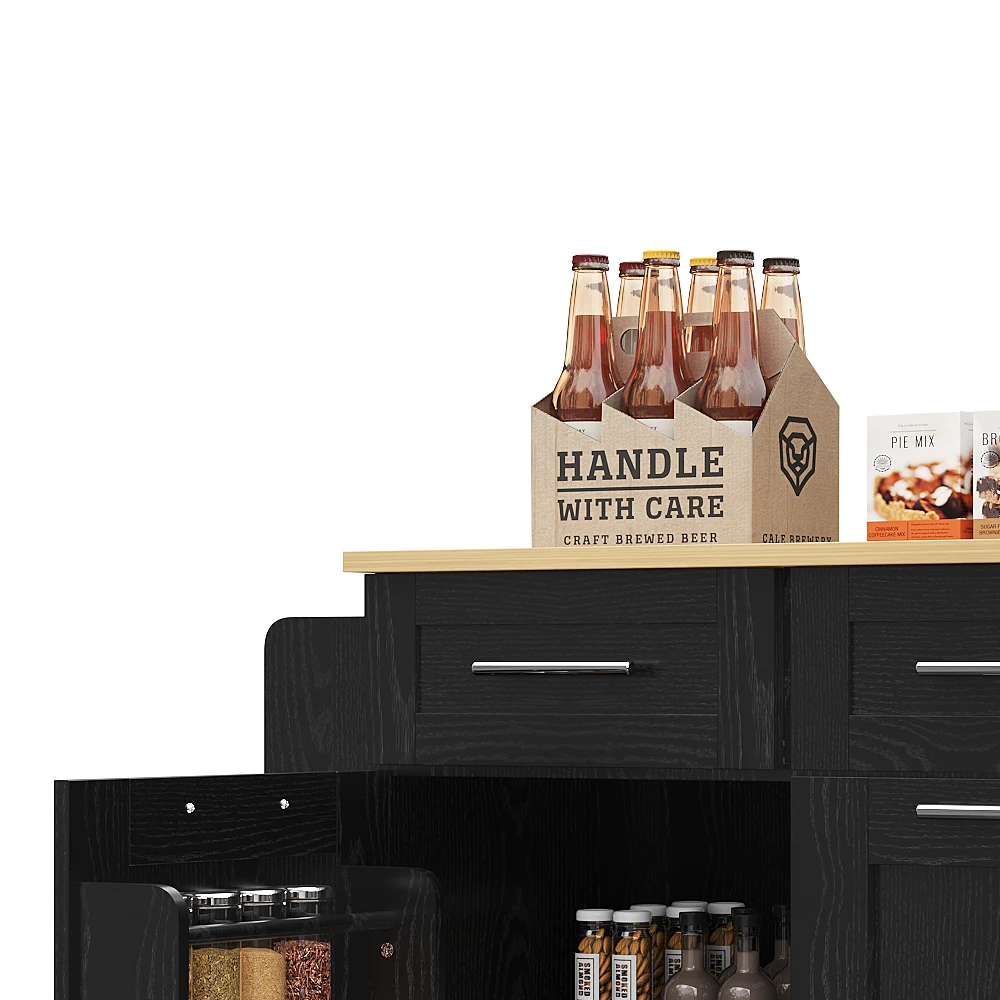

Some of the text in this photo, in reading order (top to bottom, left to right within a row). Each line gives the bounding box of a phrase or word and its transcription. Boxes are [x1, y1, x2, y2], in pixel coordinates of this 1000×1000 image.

[891, 434, 935, 449] PIE MIX
[557, 446, 724, 482] HANDLE
[557, 495, 724, 521] WITH CARE
[563, 532, 718, 546] CRAFT BREWED BEER
[762, 533, 786, 543] CALE
